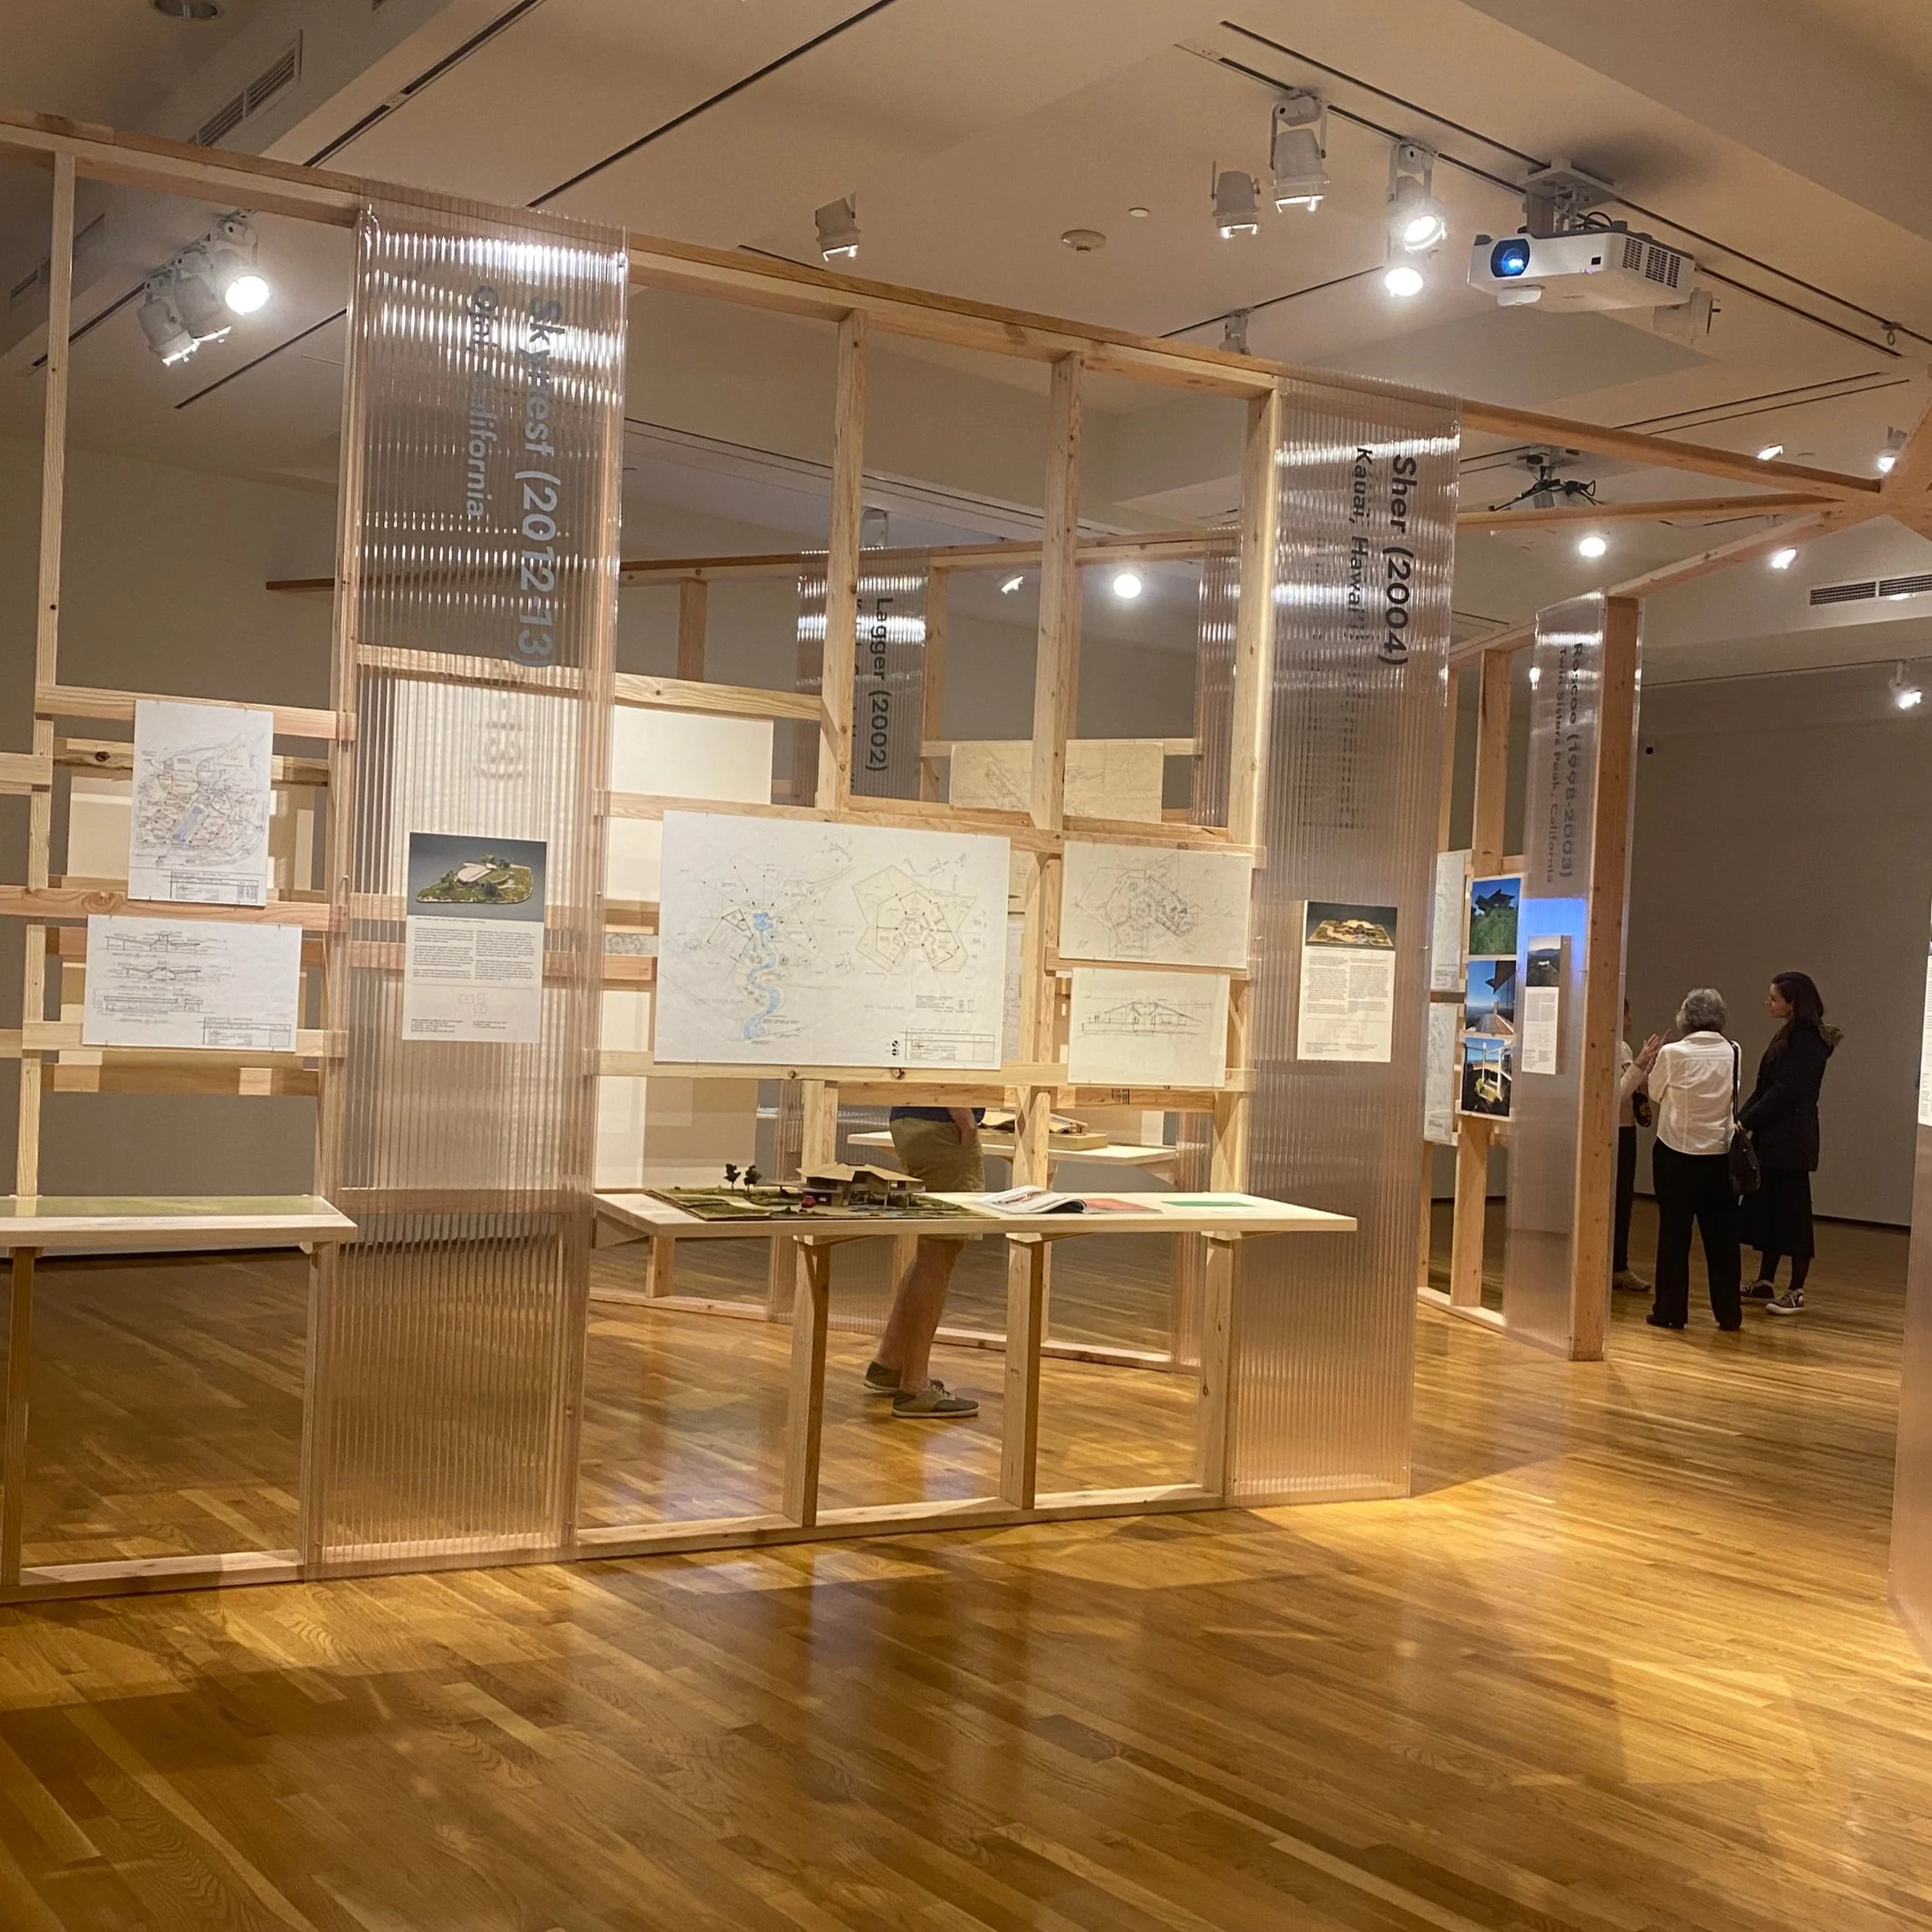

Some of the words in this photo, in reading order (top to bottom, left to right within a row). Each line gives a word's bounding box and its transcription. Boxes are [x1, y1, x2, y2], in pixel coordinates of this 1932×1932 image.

[1349, 447, 1373, 524] Kauai,
[1390, 455, 1418, 533] Sher
[511, 470, 562, 667] (2012-13)
[1378, 547, 1415, 665] (2004)
[871, 598, 894, 681] Lagger
[1558, 646, 1567, 685] Twin
[866, 690, 891, 771] (2002)
[1554, 691, 1565, 746] Sisters
[1546, 803, 1558, 884] California
